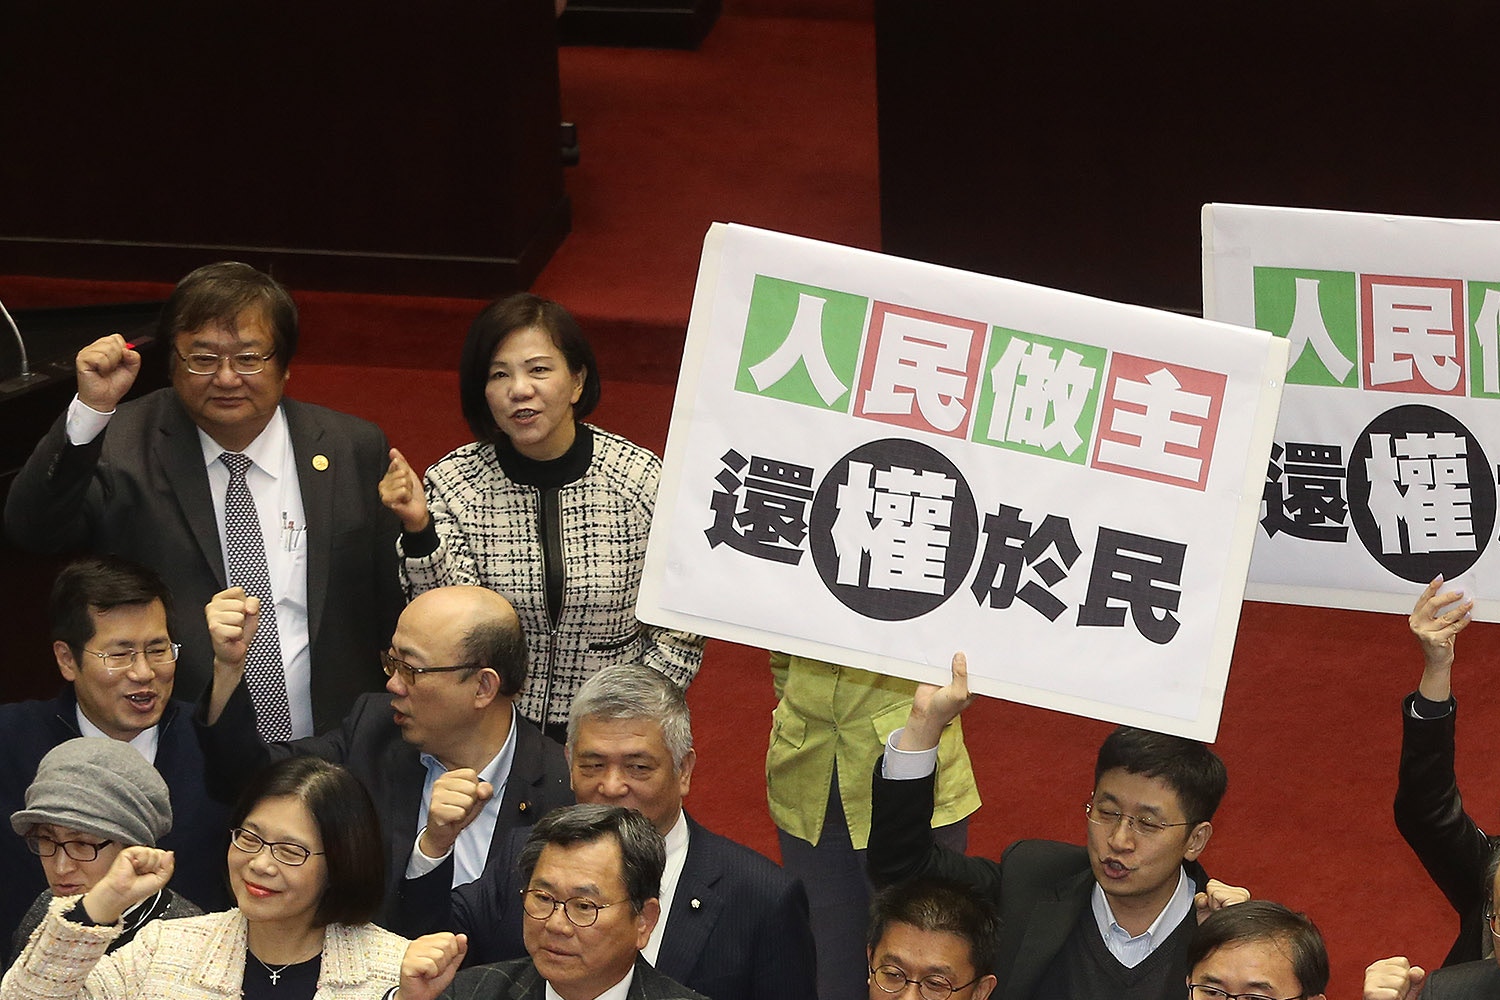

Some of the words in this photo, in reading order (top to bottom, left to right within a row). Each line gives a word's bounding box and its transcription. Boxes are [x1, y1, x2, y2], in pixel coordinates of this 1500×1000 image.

[747, 292, 1212, 483] 人民做主
[704, 447, 1188, 645] 還權於民
